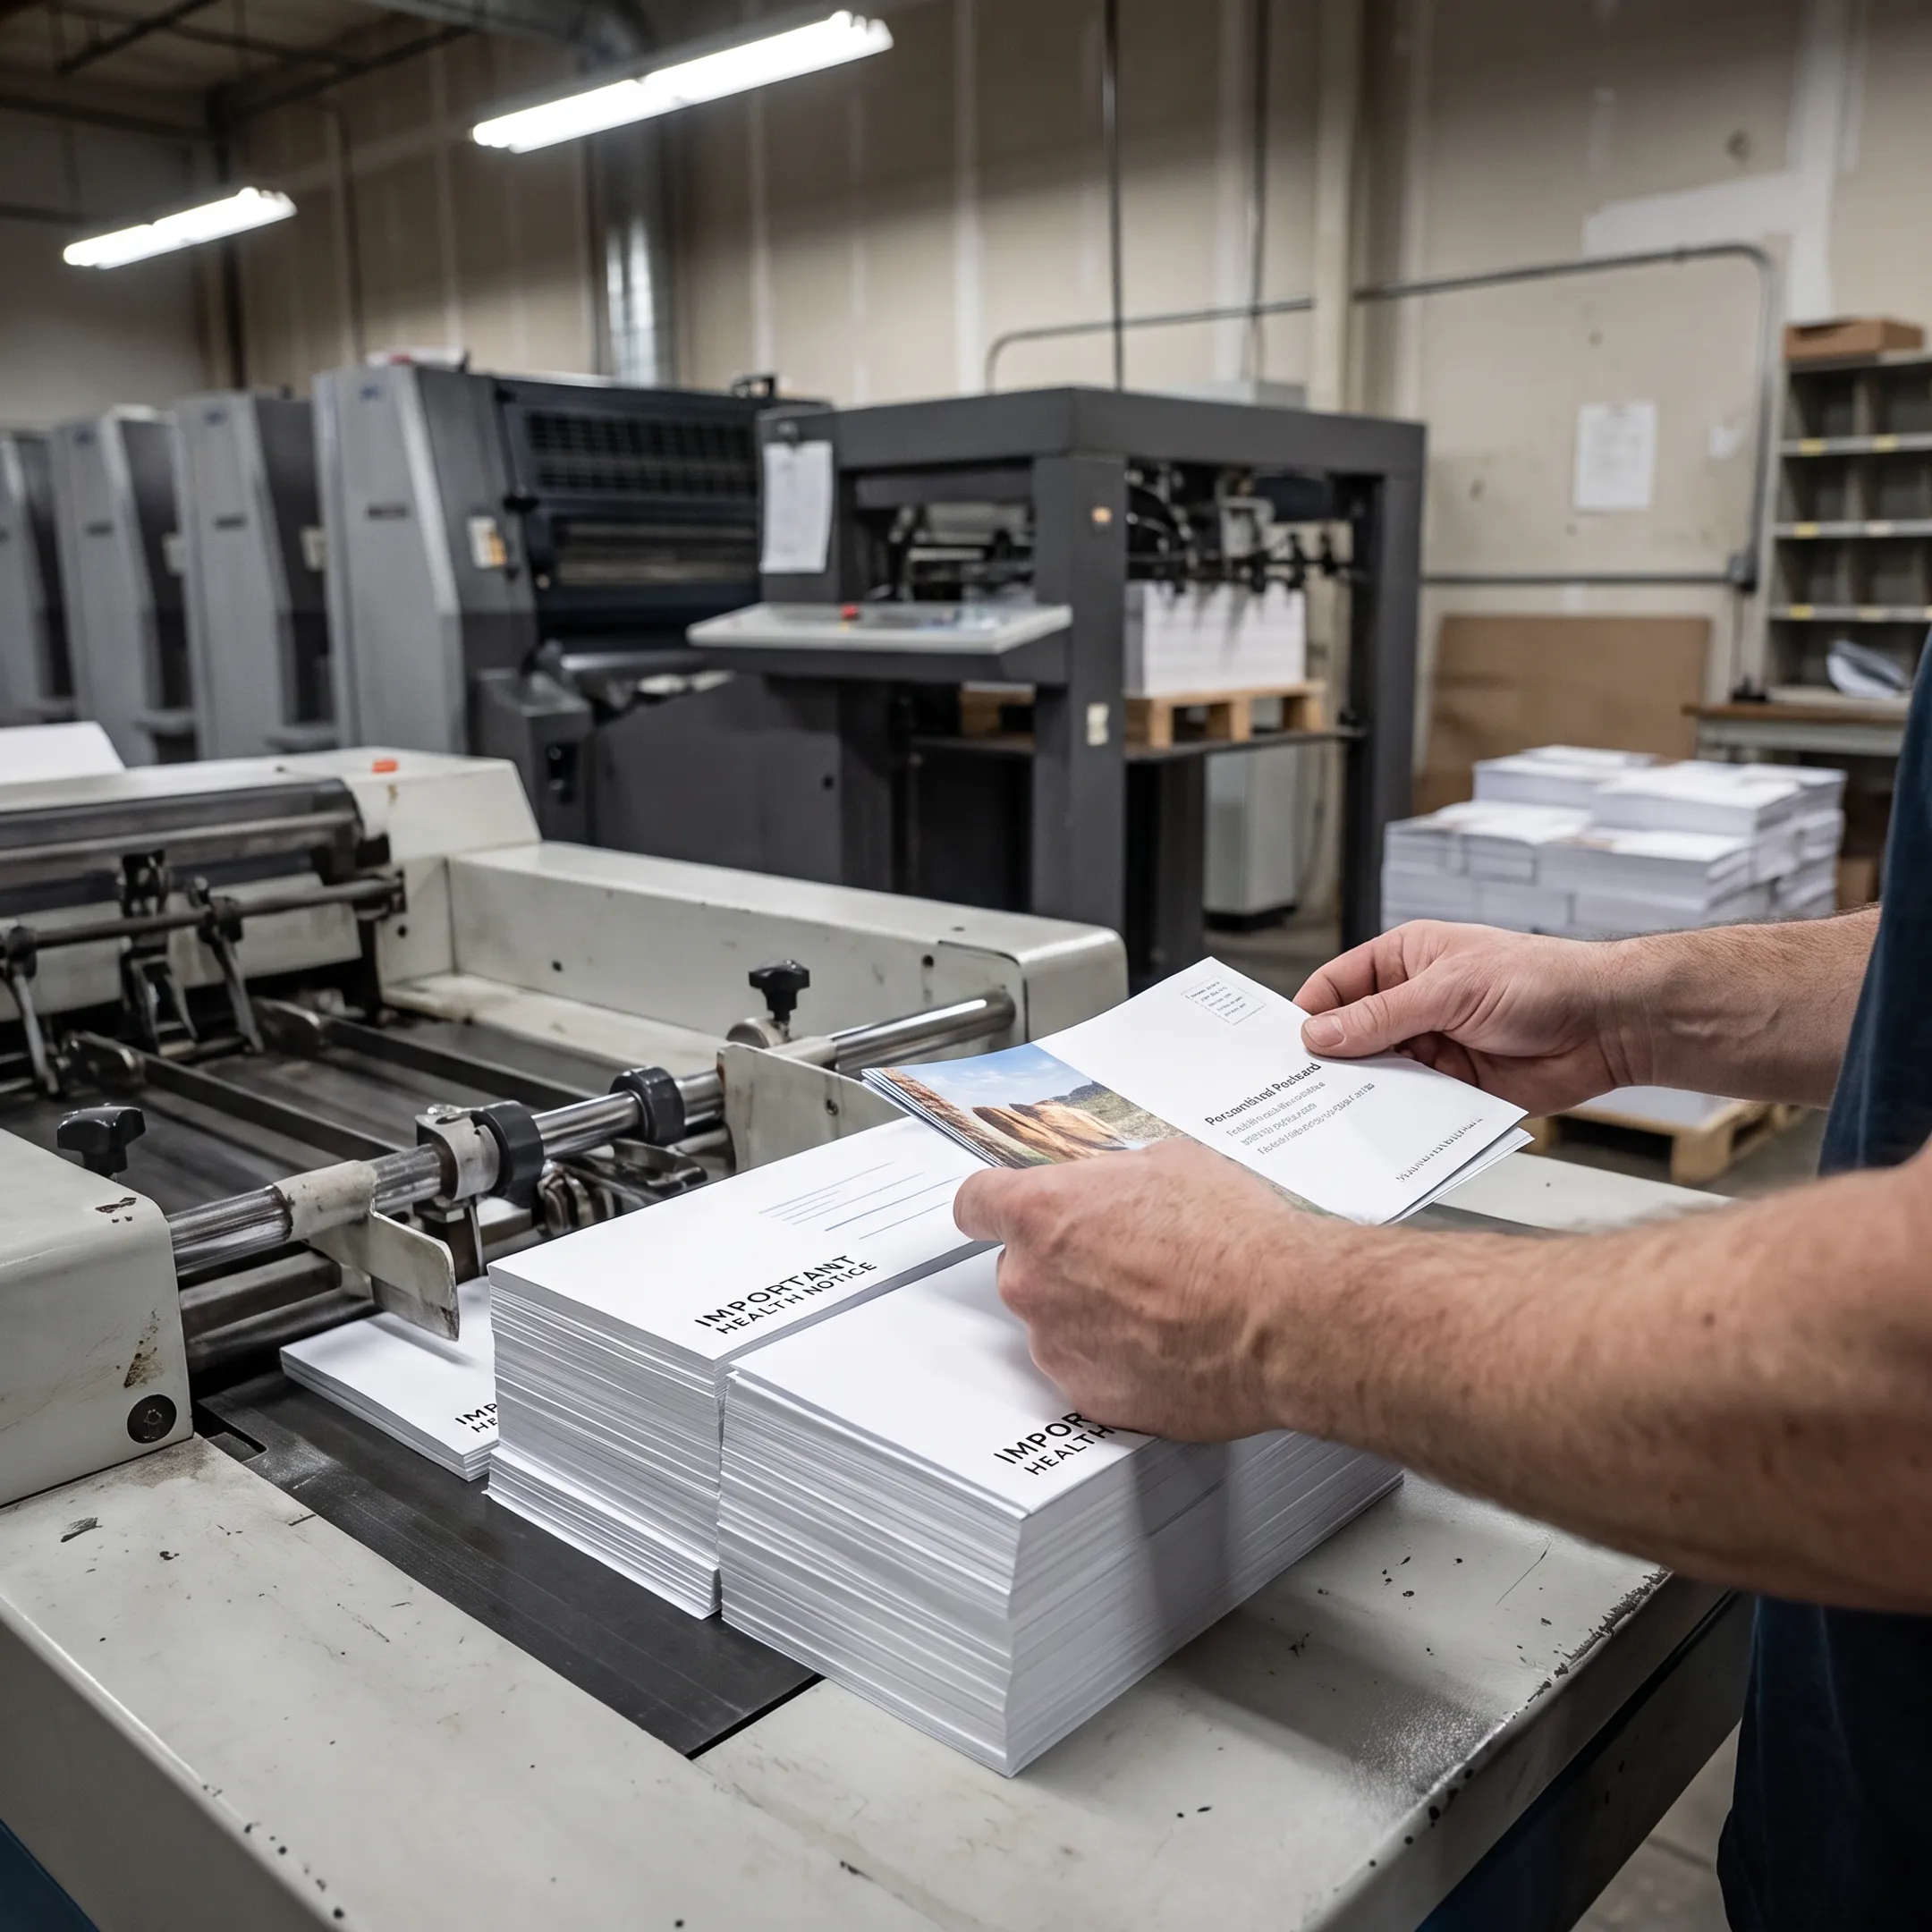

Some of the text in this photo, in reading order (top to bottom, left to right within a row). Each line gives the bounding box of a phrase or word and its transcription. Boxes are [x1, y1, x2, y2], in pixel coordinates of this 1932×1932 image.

[694, 1255, 856, 1327] IMPORTANT
[716, 1262, 877, 1335] HEALTH NOTICE
[994, 1411, 1092, 1464] IMPOR
[1023, 1424, 1115, 1476] HEALTH
